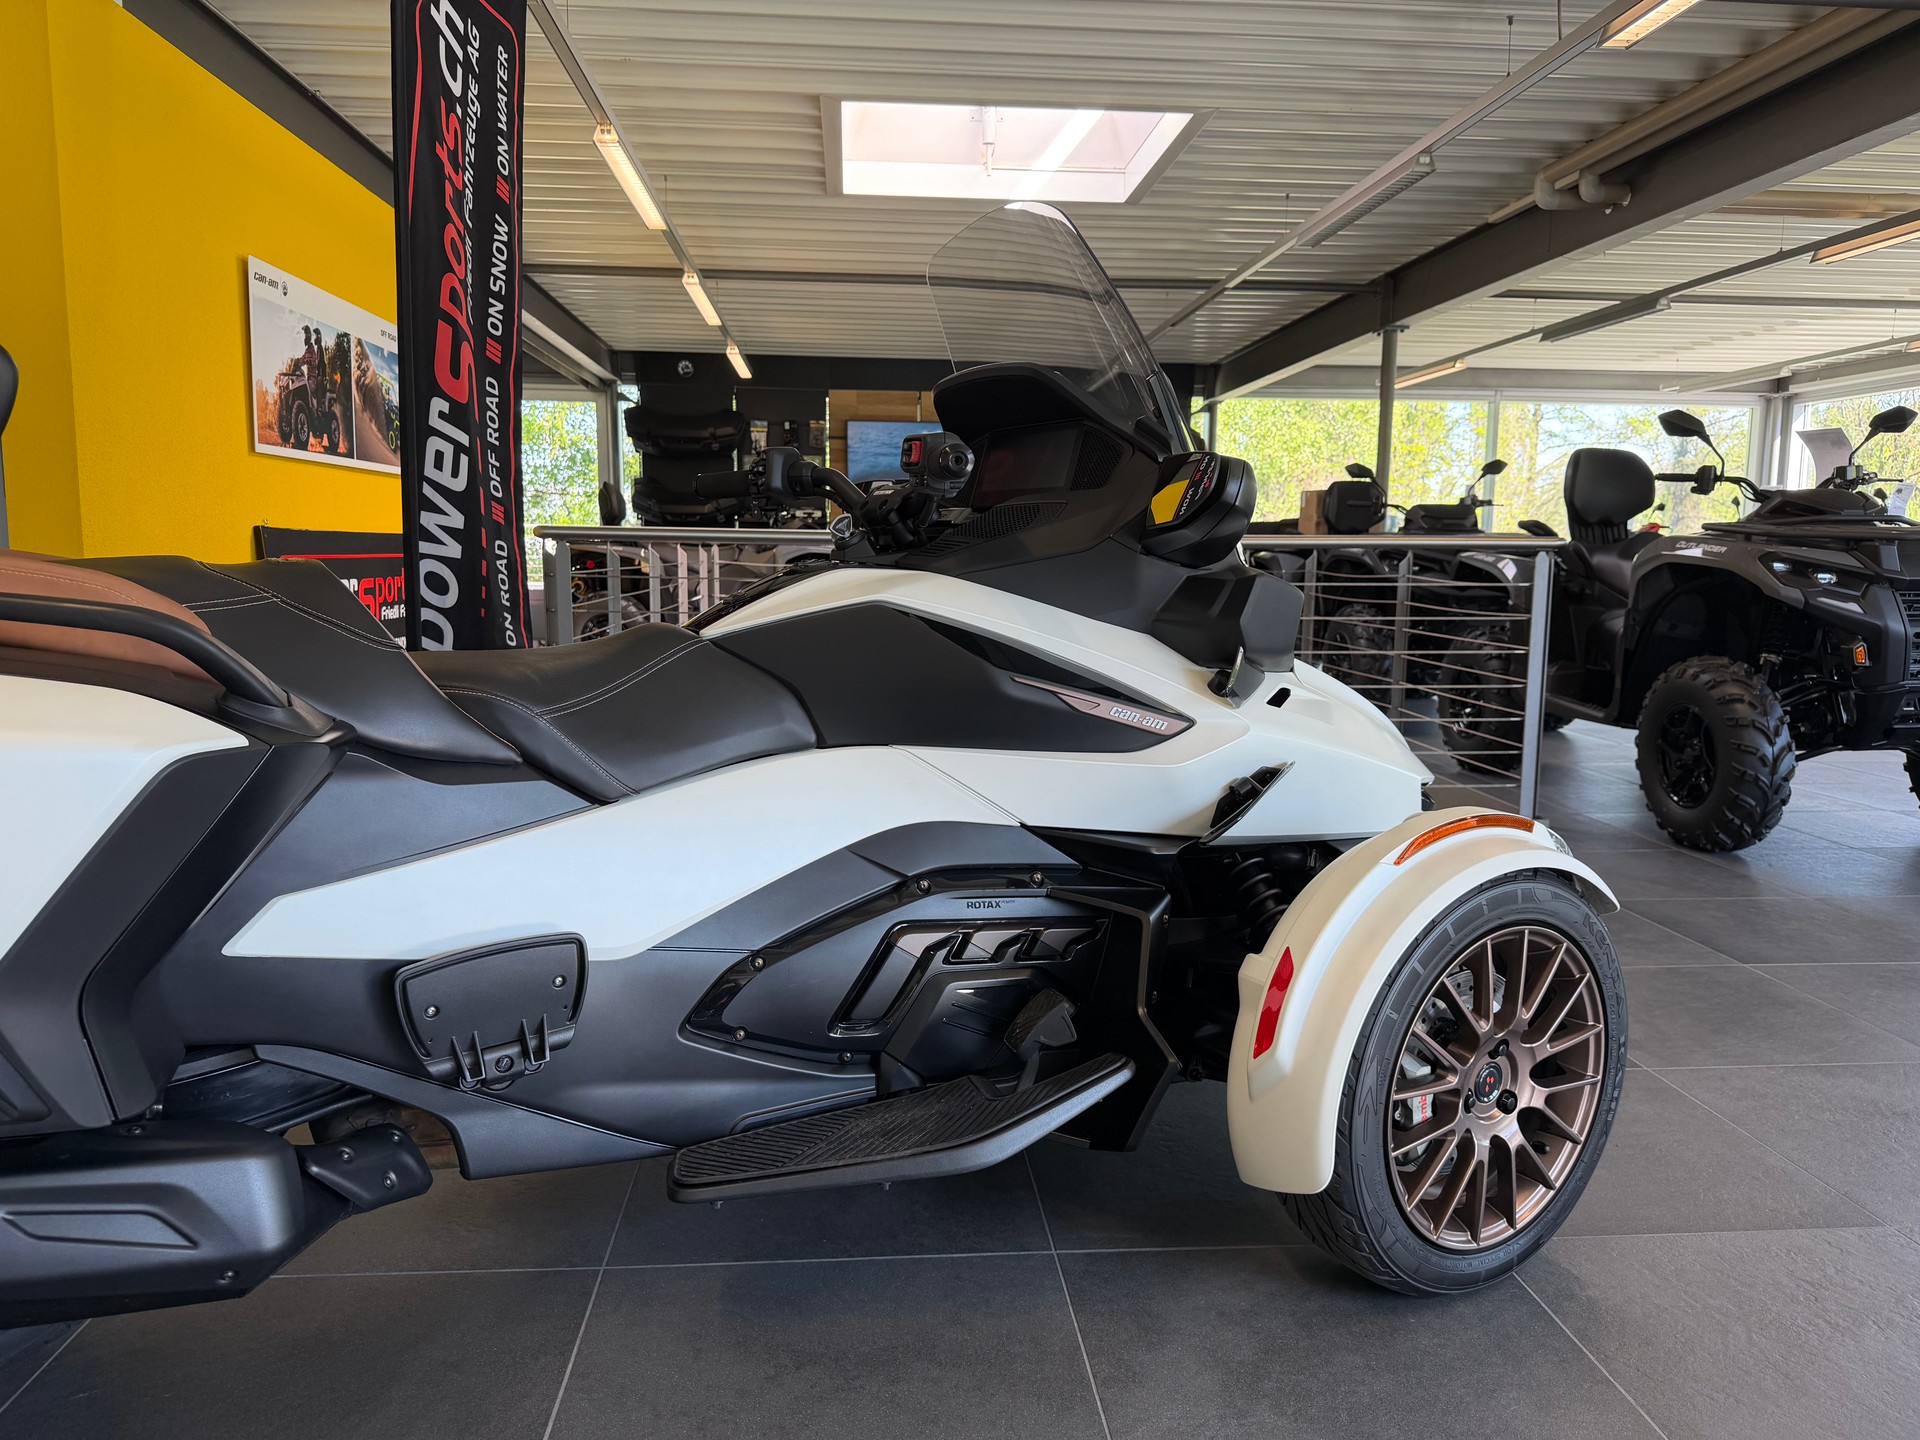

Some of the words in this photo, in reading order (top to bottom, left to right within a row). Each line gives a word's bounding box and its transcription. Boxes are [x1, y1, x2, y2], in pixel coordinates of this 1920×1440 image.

[468, 18, 480, 74] AG
[496, 44, 509, 131] WATER
[463, 73, 481, 229] Fahrzeuge
[496, 138, 510, 176] ON
[489, 213, 510, 296] SNOW
[253, 271, 279, 290] can-am
[486, 297, 504, 337] ON
[486, 375, 501, 447] ROAD
[489, 448, 504, 498] OFF
[1675, 540, 1728, 553] OUTLANDER
[494, 538, 510, 606] ROAD
[504, 610, 517, 648] ON
[1109, 706, 1168, 731] can-am
[966, 900, 1001, 909] ROTAX
